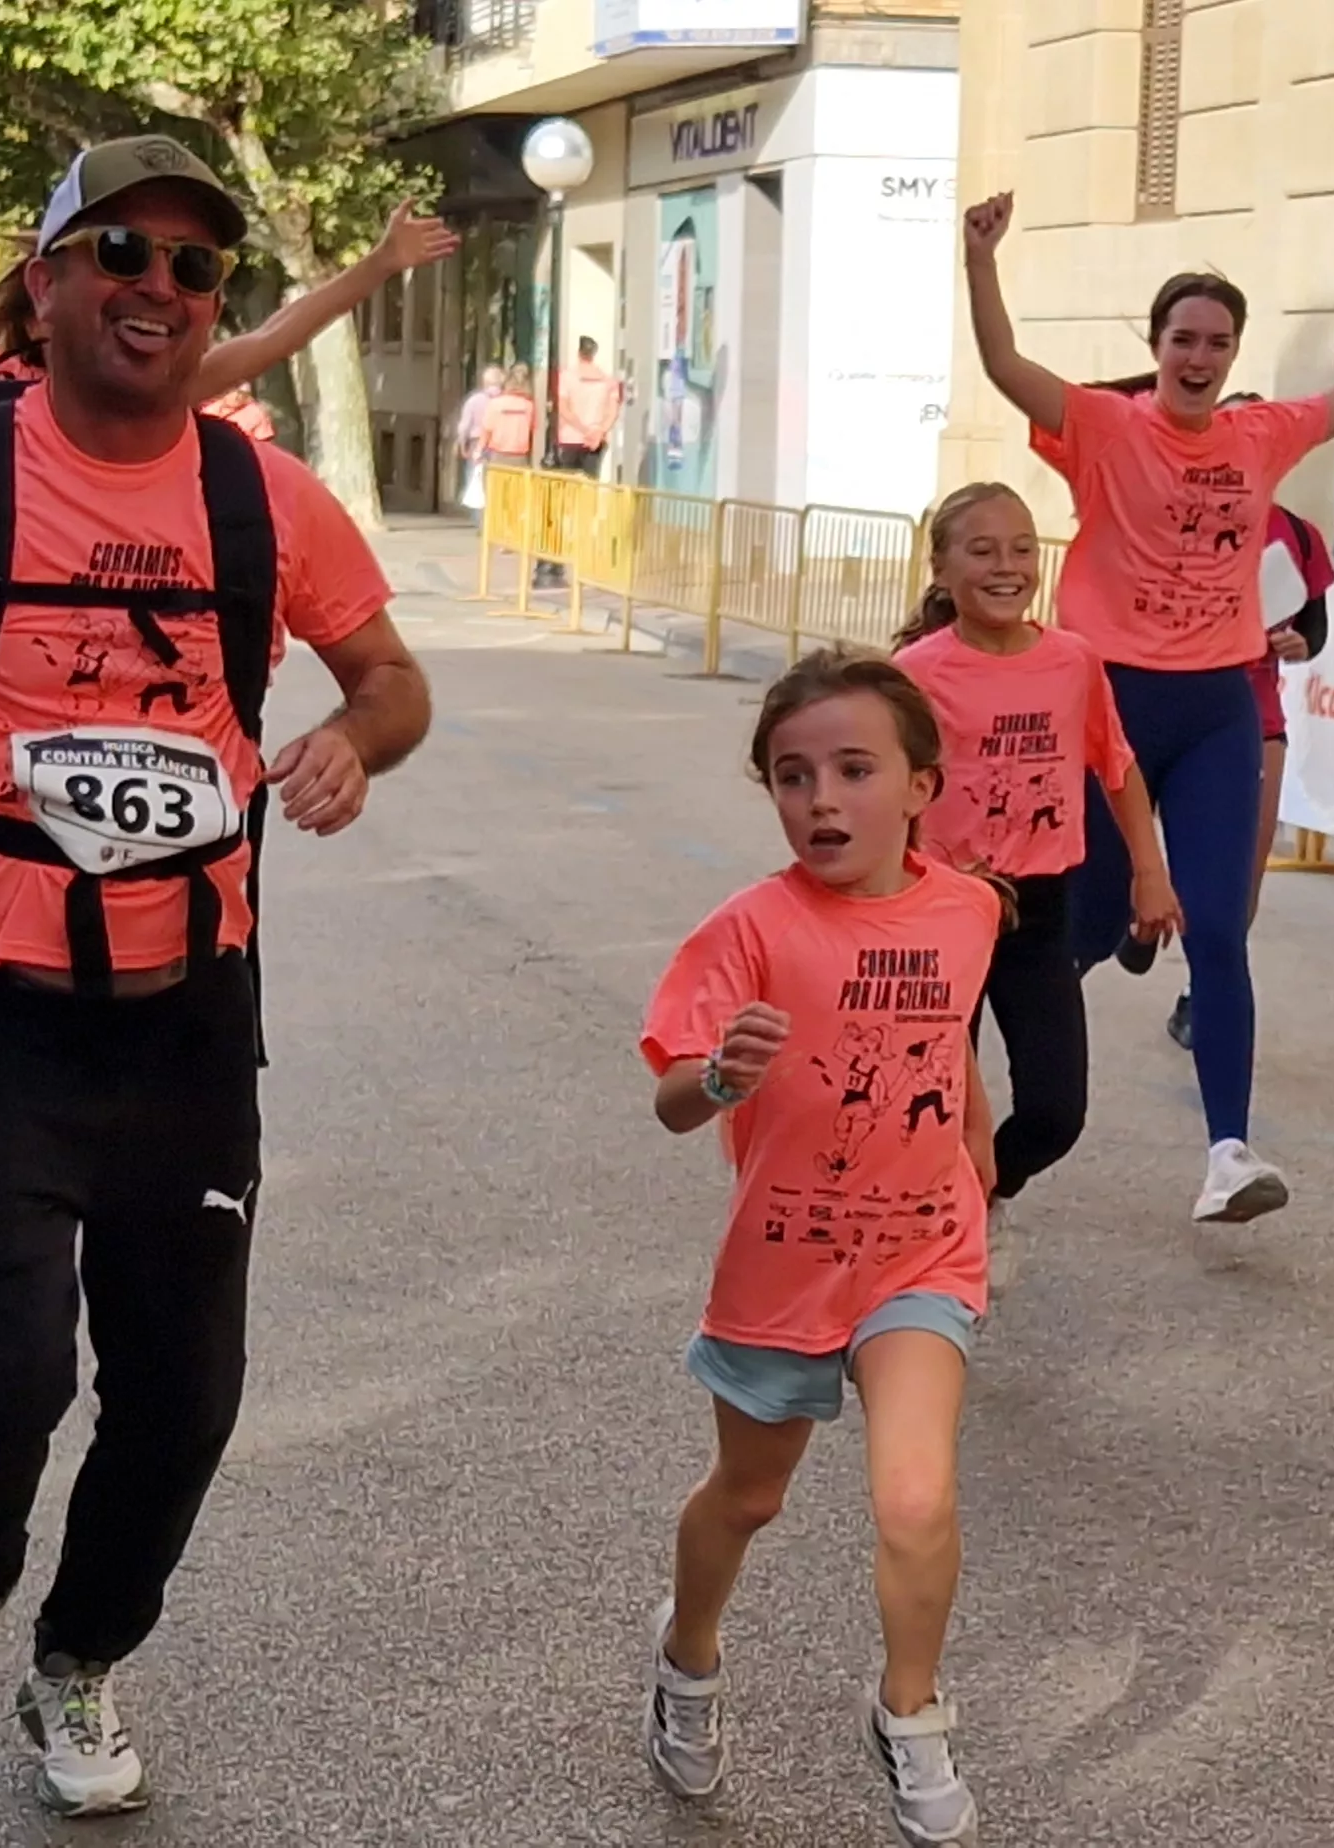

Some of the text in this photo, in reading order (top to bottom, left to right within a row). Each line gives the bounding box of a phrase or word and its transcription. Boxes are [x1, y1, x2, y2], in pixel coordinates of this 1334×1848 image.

[880, 176, 938, 198] SMY
[89, 541, 184, 577] CORRAMOS
[40, 750, 117, 767] CONTRA
[121, 753, 142, 769] EL
[103, 740, 156, 755] HUESCA
[65, 773, 196, 839] 863
[857, 948, 939, 978] CORRAMOS
[837, 979, 951, 1011] POR LA CIENCIA
